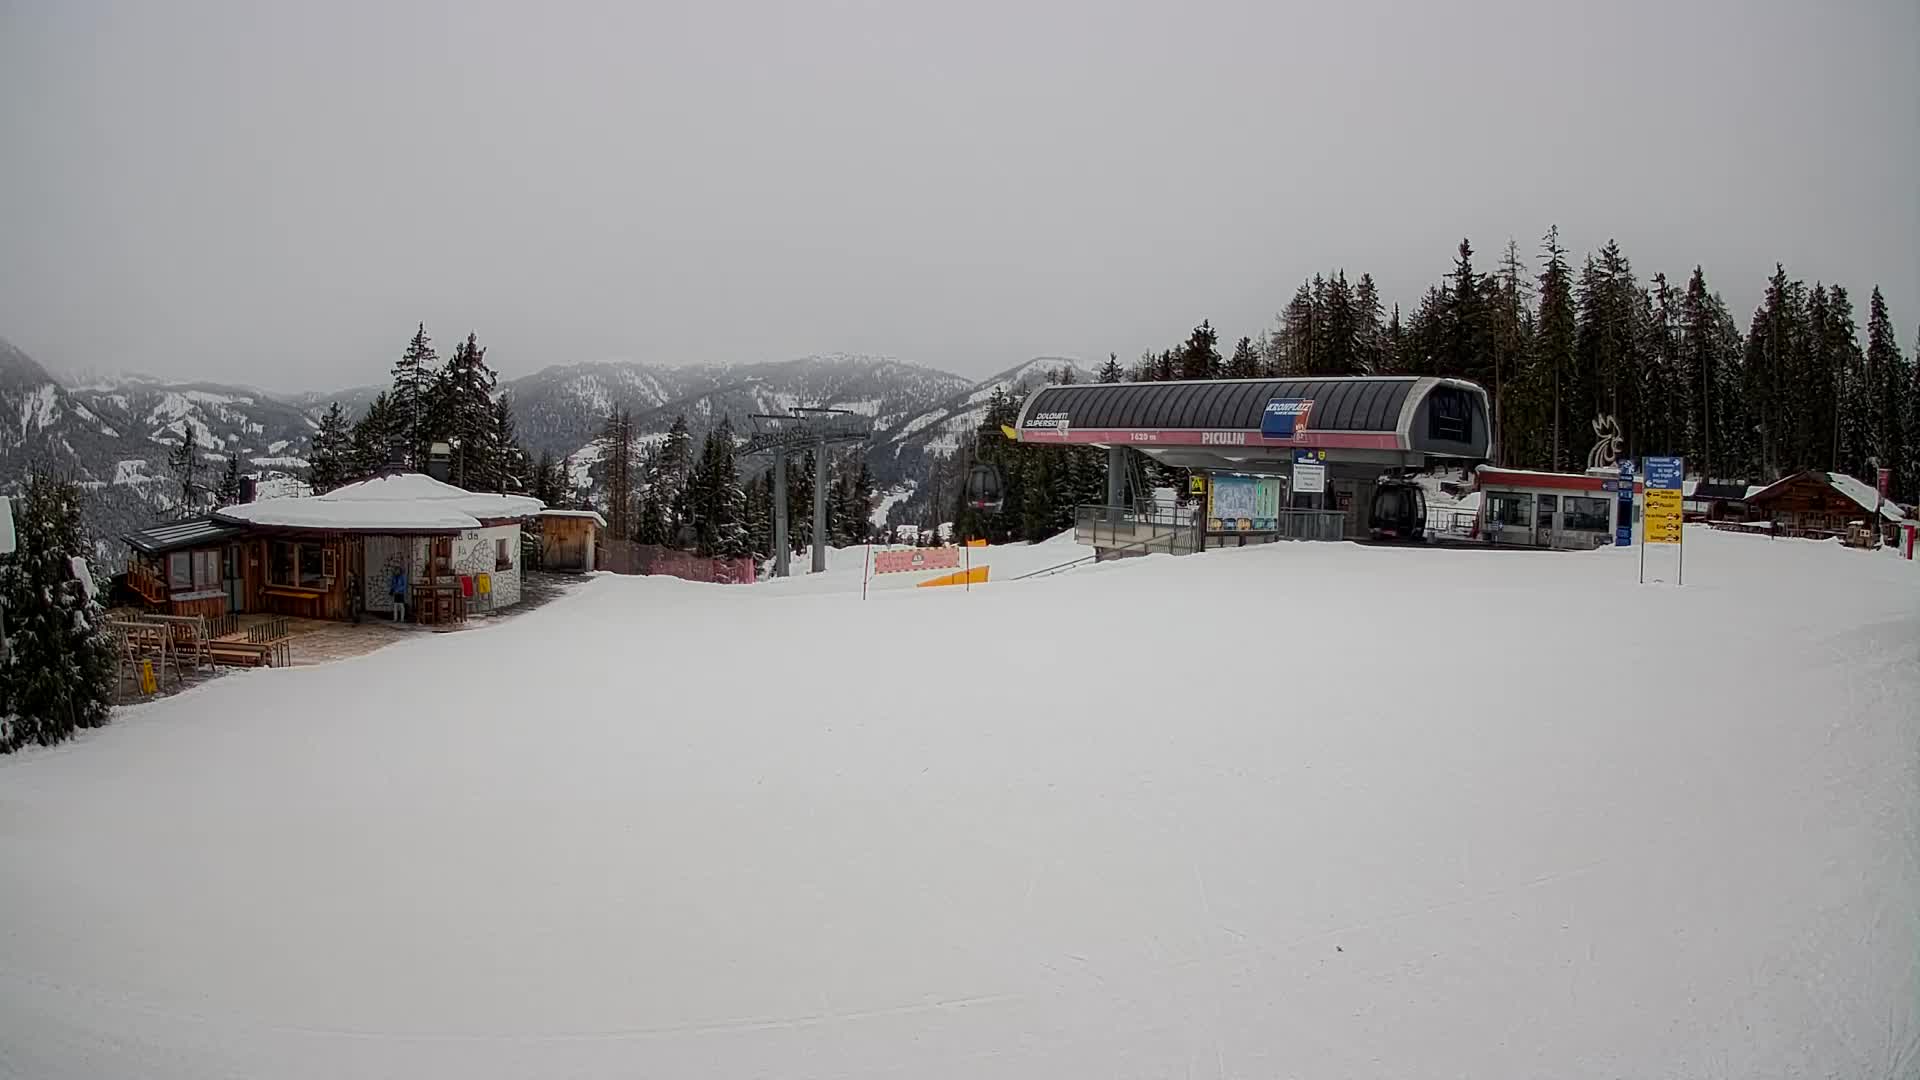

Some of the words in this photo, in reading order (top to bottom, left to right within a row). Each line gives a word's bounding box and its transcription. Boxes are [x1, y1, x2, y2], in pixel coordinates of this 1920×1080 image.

[1266, 403, 1309, 411] KRONPLATZ
[1026, 419, 1058, 427] SUPERSKI
[1201, 432, 1245, 445] PICULIN
